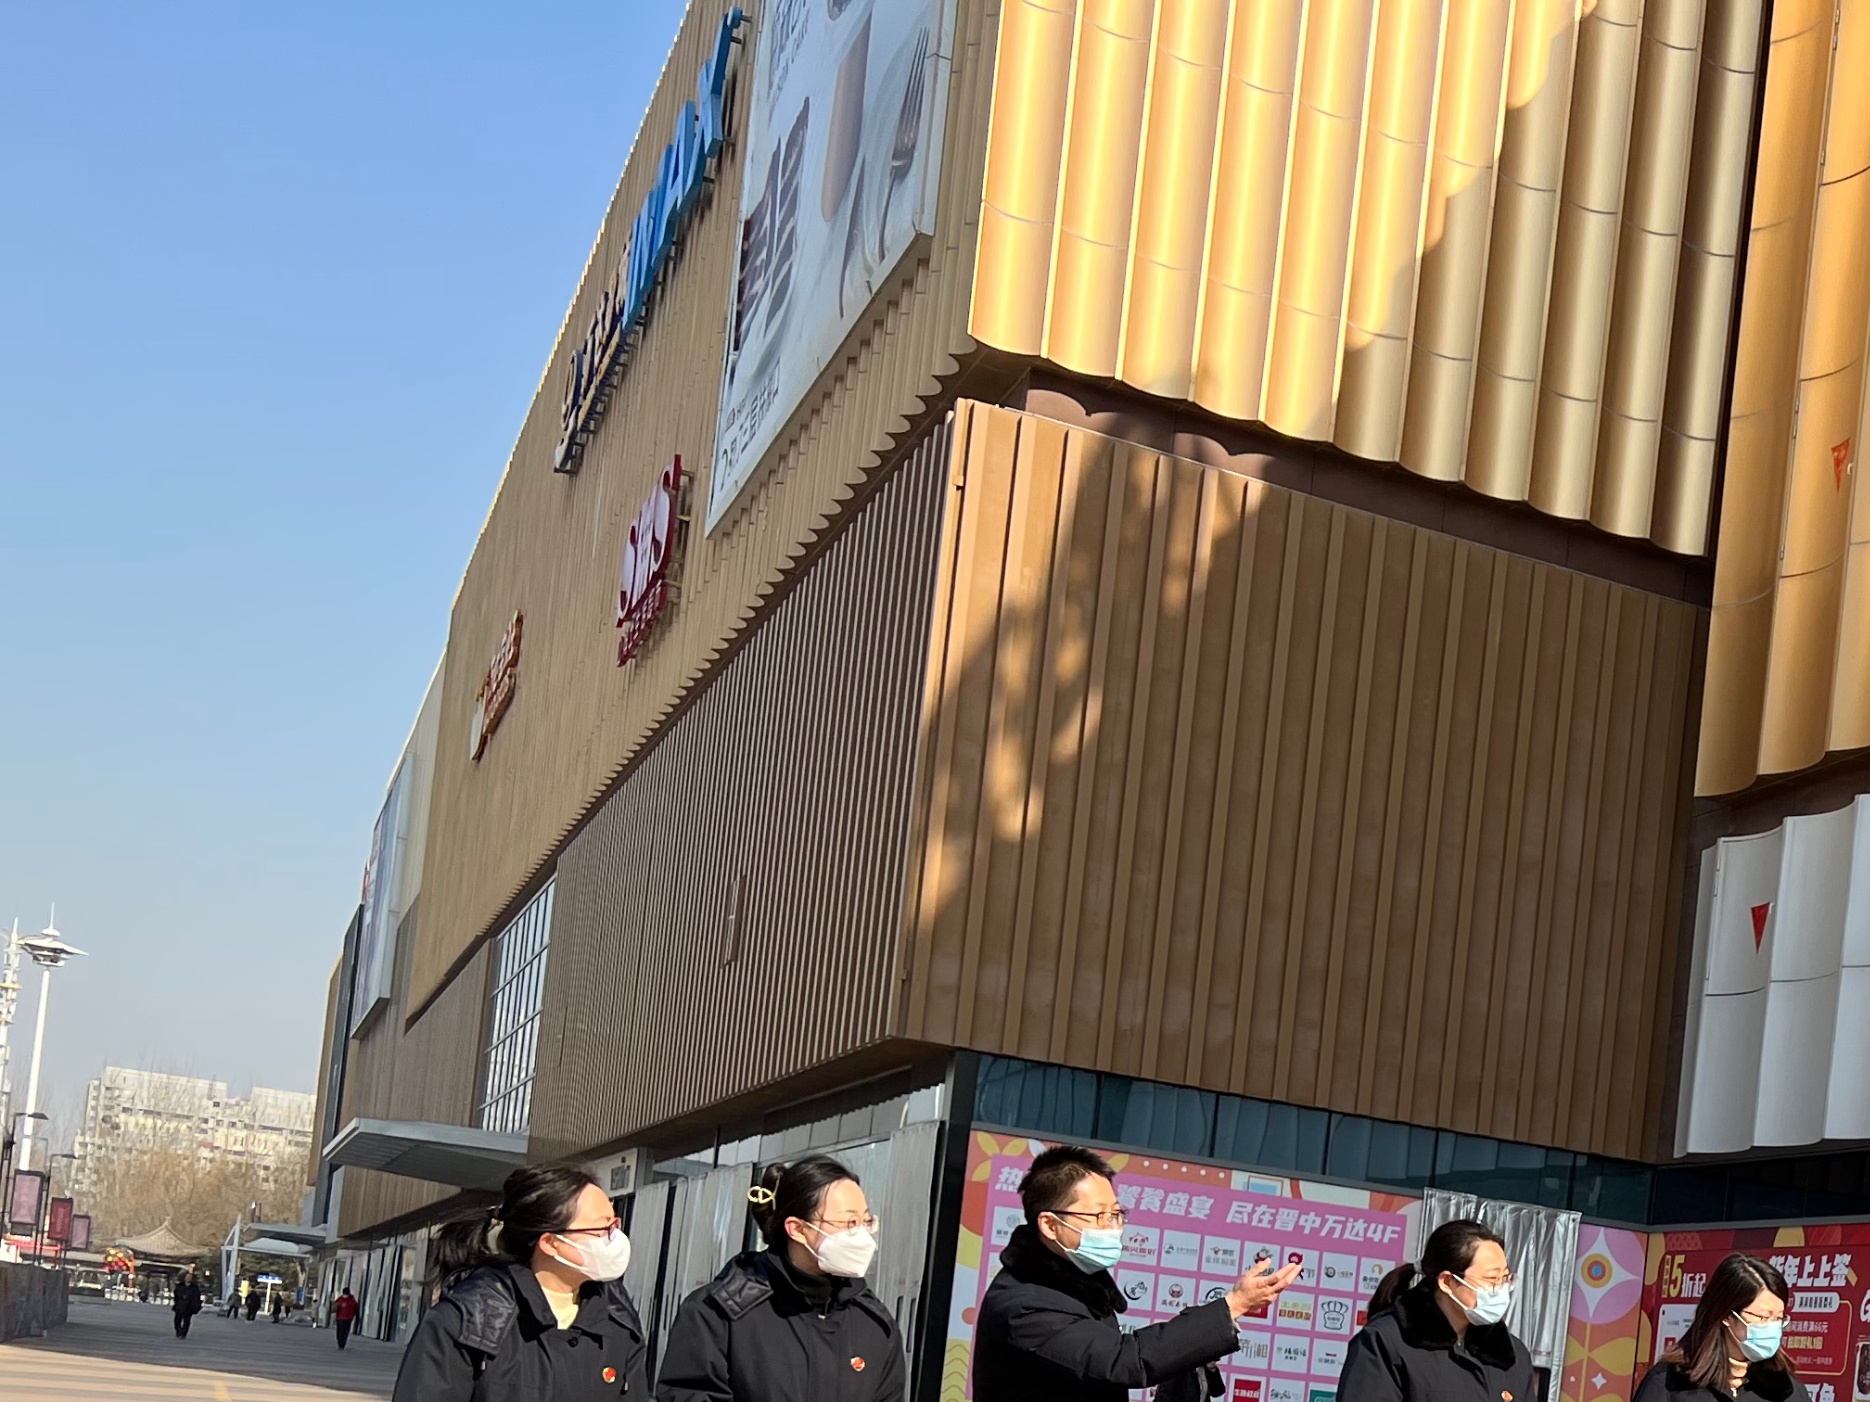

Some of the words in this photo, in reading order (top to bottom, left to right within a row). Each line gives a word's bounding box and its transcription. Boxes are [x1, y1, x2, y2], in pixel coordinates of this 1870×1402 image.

[1226, 1200, 1402, 1244] 尽在晋中万达4F
